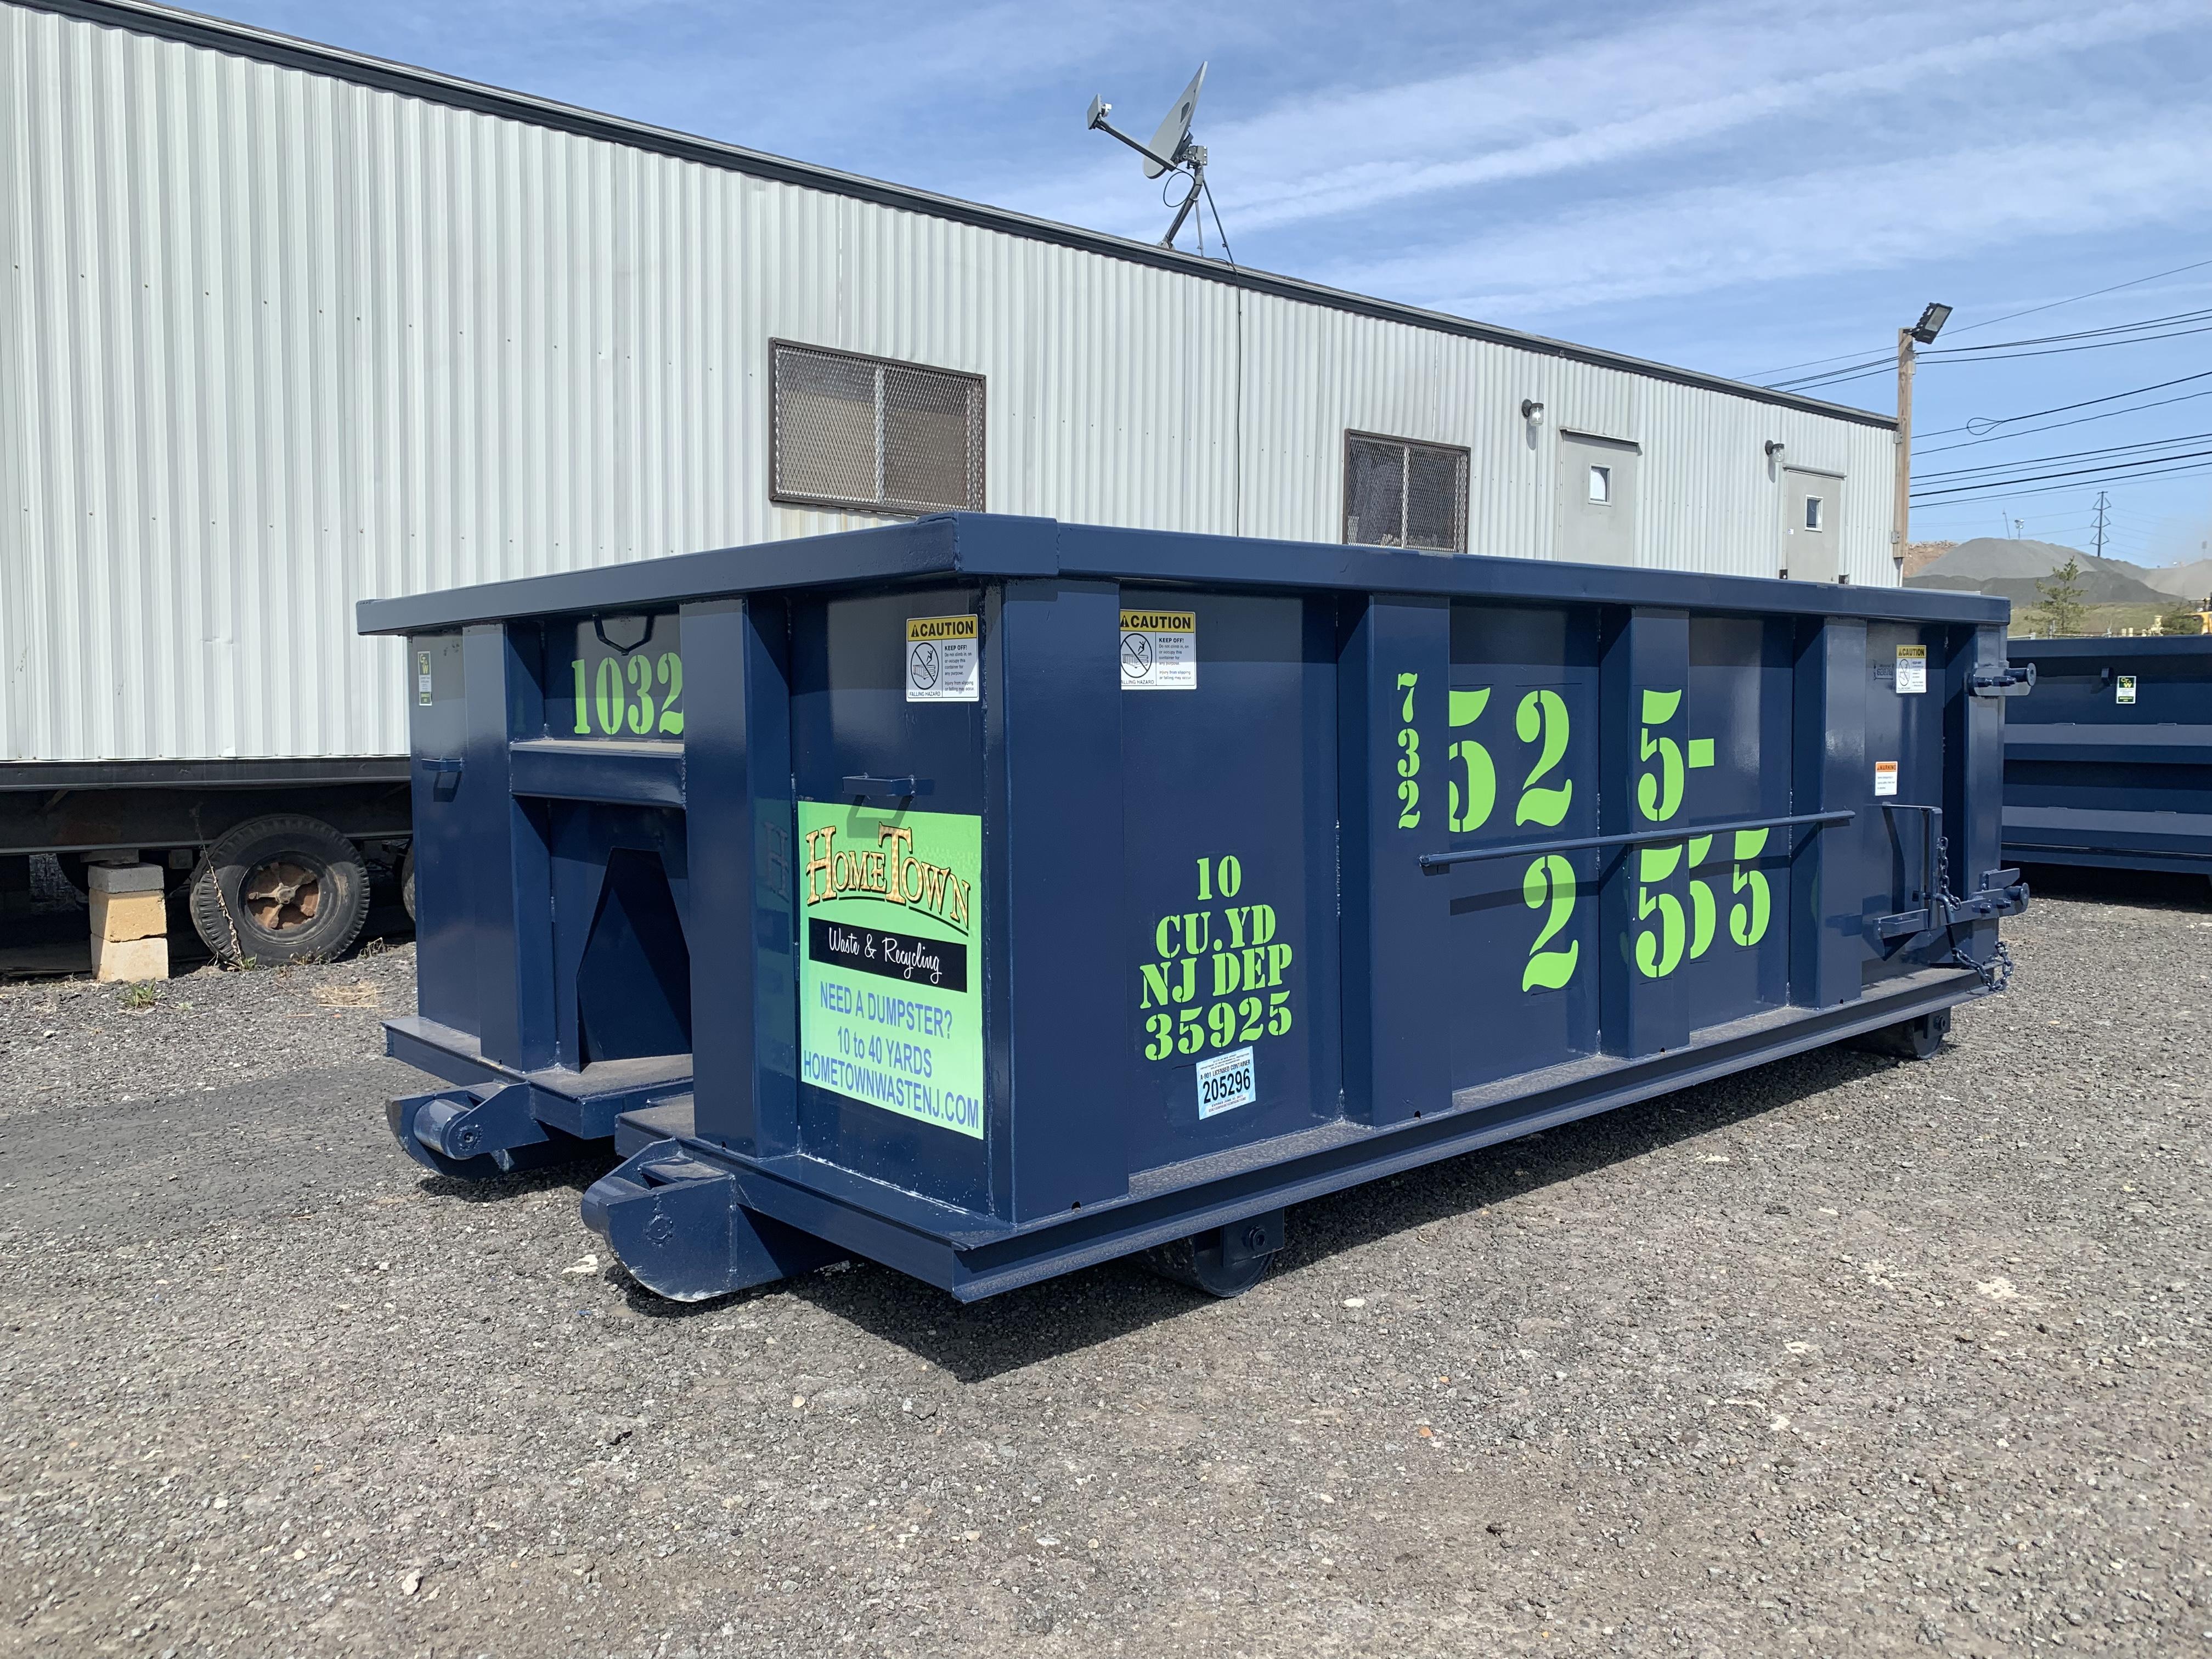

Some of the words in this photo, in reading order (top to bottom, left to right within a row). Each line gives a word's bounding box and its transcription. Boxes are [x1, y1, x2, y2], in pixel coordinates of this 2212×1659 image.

[920, 620, 973, 637] CAUTION
[1131, 615, 1191, 629] CAUTION
[572, 652, 684, 735] 1032
[1397, 673, 1420, 829] 732
[1197, 855, 1242, 901] 10
[829, 927, 860, 955] Waste
[864, 934, 877, 959] &
[882, 937, 943, 984] Recycling
[1155, 904, 1276, 958] CU.YD
[1139, 957, 1198, 1009] NJ
[1212, 943, 1293, 997] DEP
[820, 981, 851, 1014] NEED
[855, 990, 865, 1019] A
[868, 992, 953, 1040] DUMPSTER?
[1145, 990, 1293, 1061] 35925
[838, 1026, 850, 1055] 10
[853, 1032, 865, 1059] to
[868, 1035, 883, 1064] 40
[885, 1039, 932, 1079] YARDS
[1200, 1072, 1211, 1080] A-901
[1212, 1066, 1230, 1076] LICENSED
[1230, 1059, 1251, 1071] CONTAINER
[804, 1049, 979, 1130] HOMETOWNWASTENJ.COM
[1203, 1068, 1251, 1104] 205296
